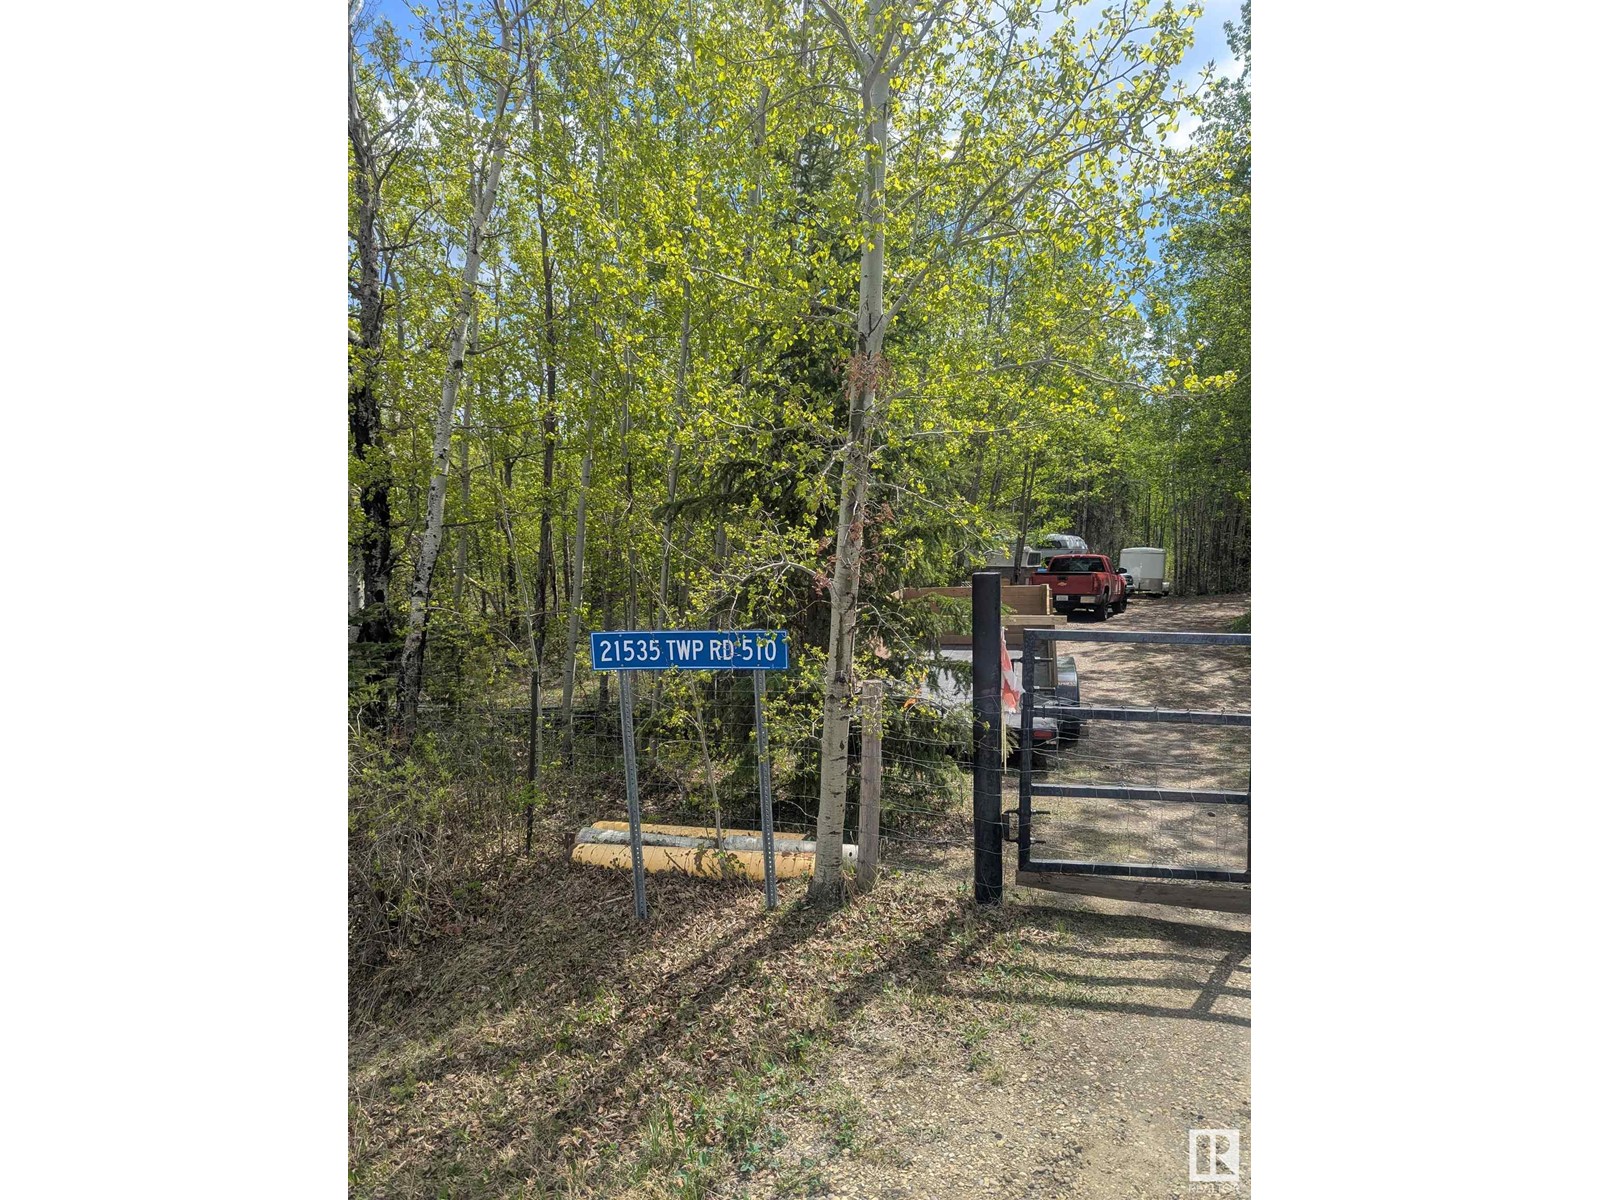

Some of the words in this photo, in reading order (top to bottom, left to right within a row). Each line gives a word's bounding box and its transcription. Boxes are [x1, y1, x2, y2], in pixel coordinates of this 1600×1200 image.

[599, 639, 661, 662] 21535
[665, 639, 704, 661] TWP
[709, 639, 735, 661] RD
[741, 639, 777, 662] 510
